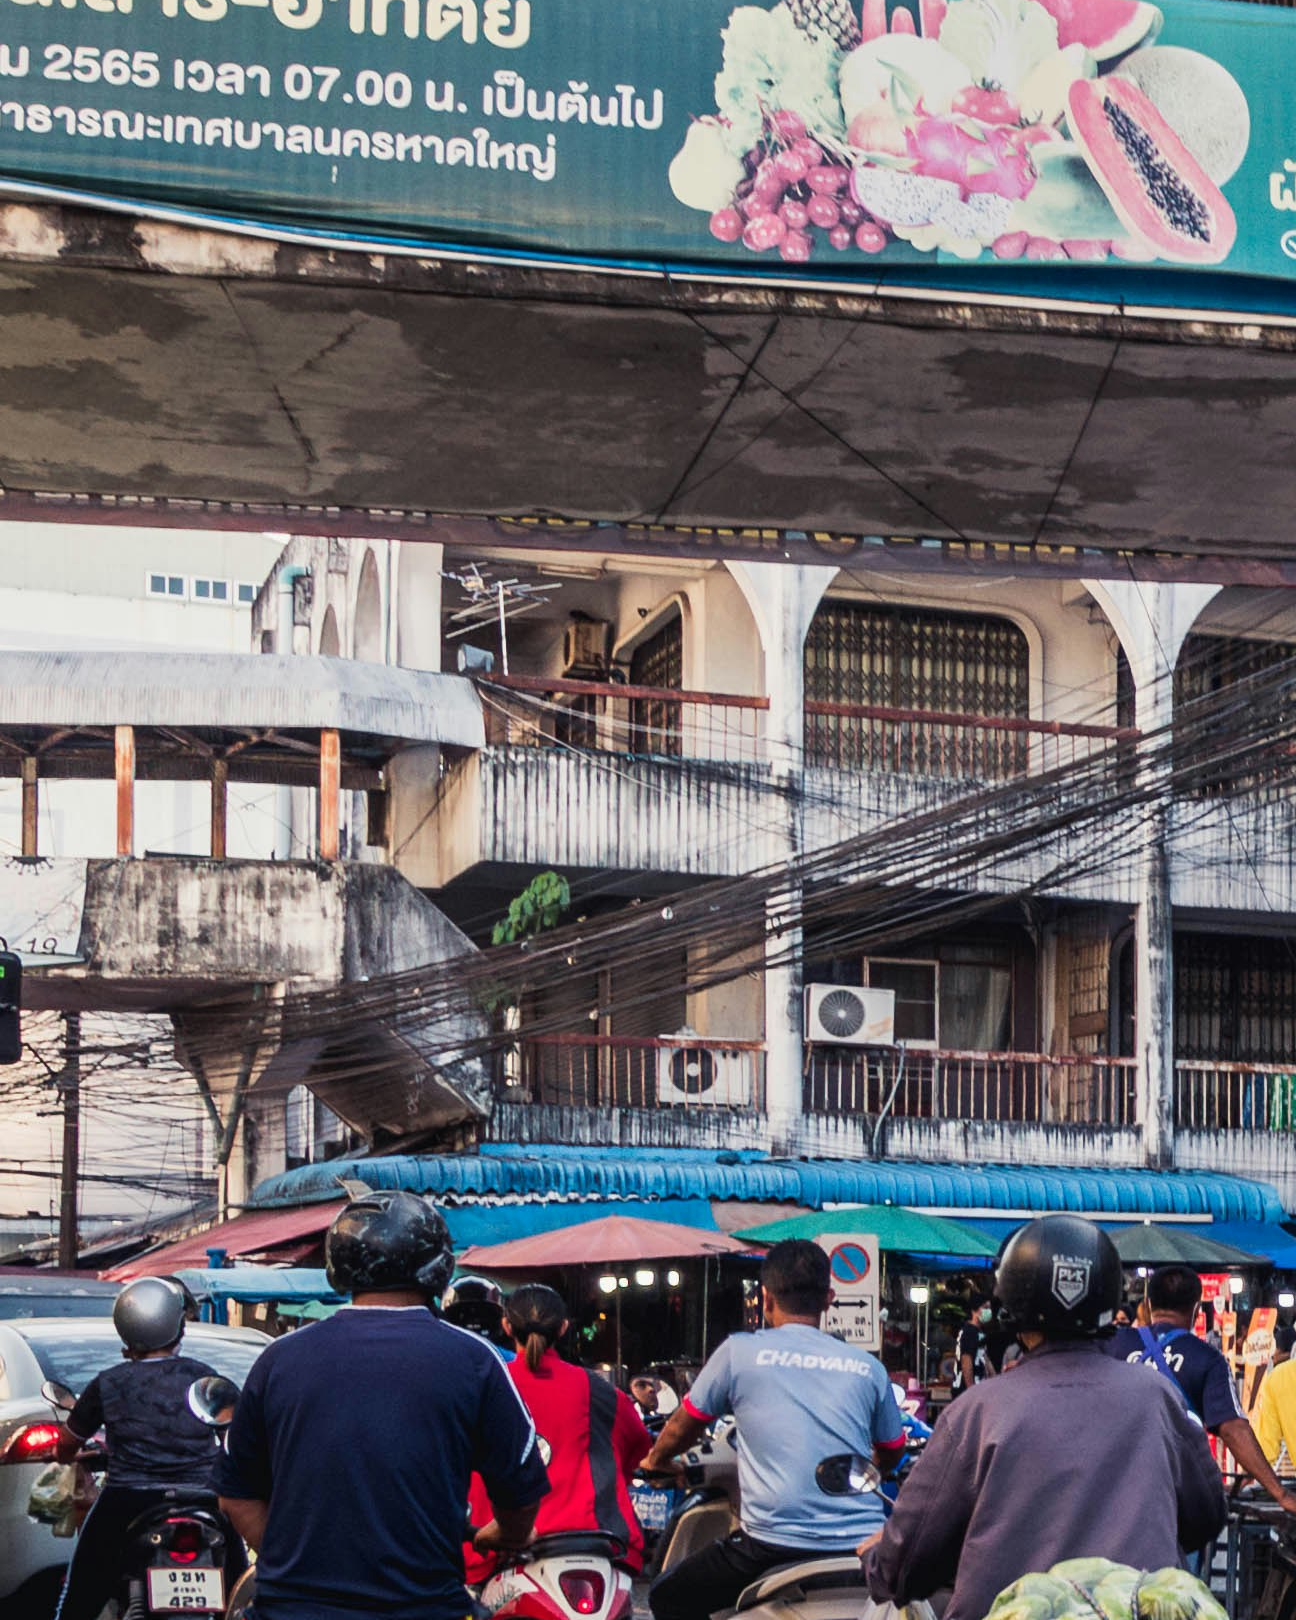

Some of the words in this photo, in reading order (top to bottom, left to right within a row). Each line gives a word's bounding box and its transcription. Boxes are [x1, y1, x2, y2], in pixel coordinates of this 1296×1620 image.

[43, 44, 160, 88] 2565
[174, 59, 271, 98] เวลา
[284, 64, 412, 108] 07.00
[425, 80, 467, 113] น.
[483, 70, 663, 130] เป็นต้นไป
[0, 102, 556, 181] าธารณะเทศบาลนครหาดใหญ่
[169, 1596, 207, 1608] 429
